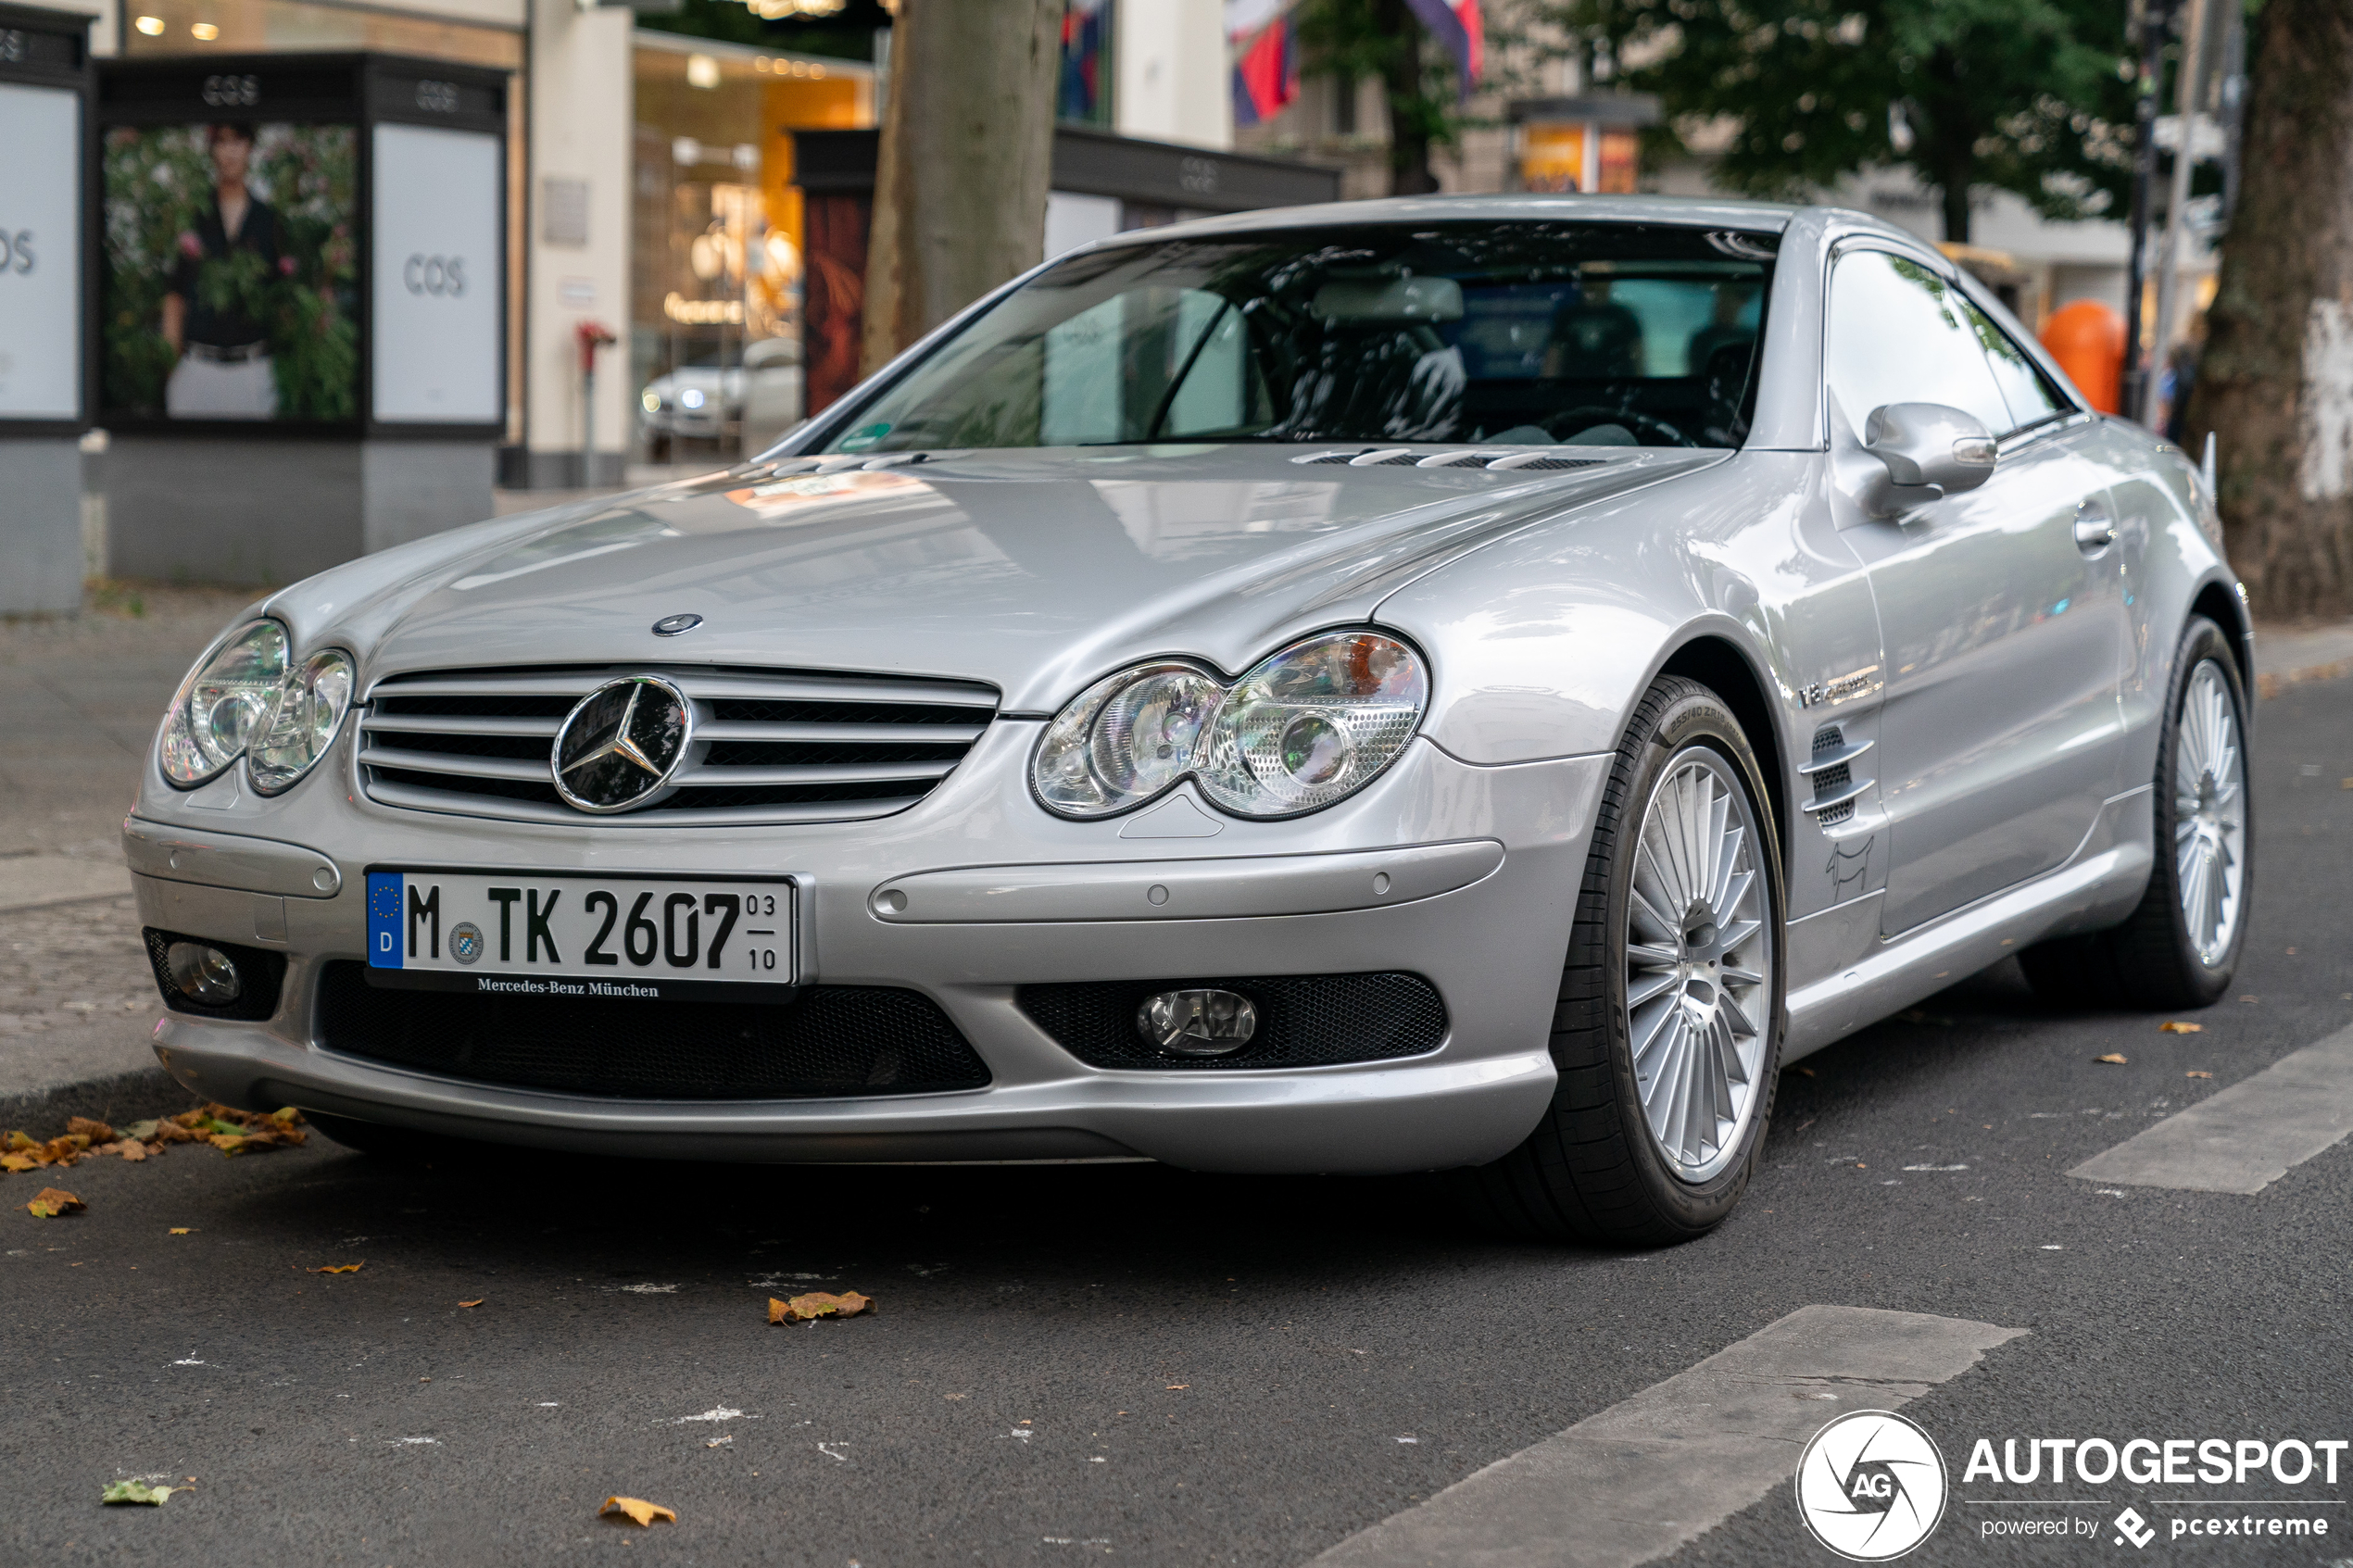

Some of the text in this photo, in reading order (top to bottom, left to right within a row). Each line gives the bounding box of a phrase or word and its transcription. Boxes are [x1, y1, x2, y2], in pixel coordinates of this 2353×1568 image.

[403, 252, 468, 297] COS
[1670, 707, 1703, 735] 255/40
[746, 894, 775, 916] 03
[408, 884, 741, 970] M TK 2607
[380, 932, 393, 953] D
[749, 948, 775, 970] 10
[477, 977, 660, 998] Mercedes-Benz München
